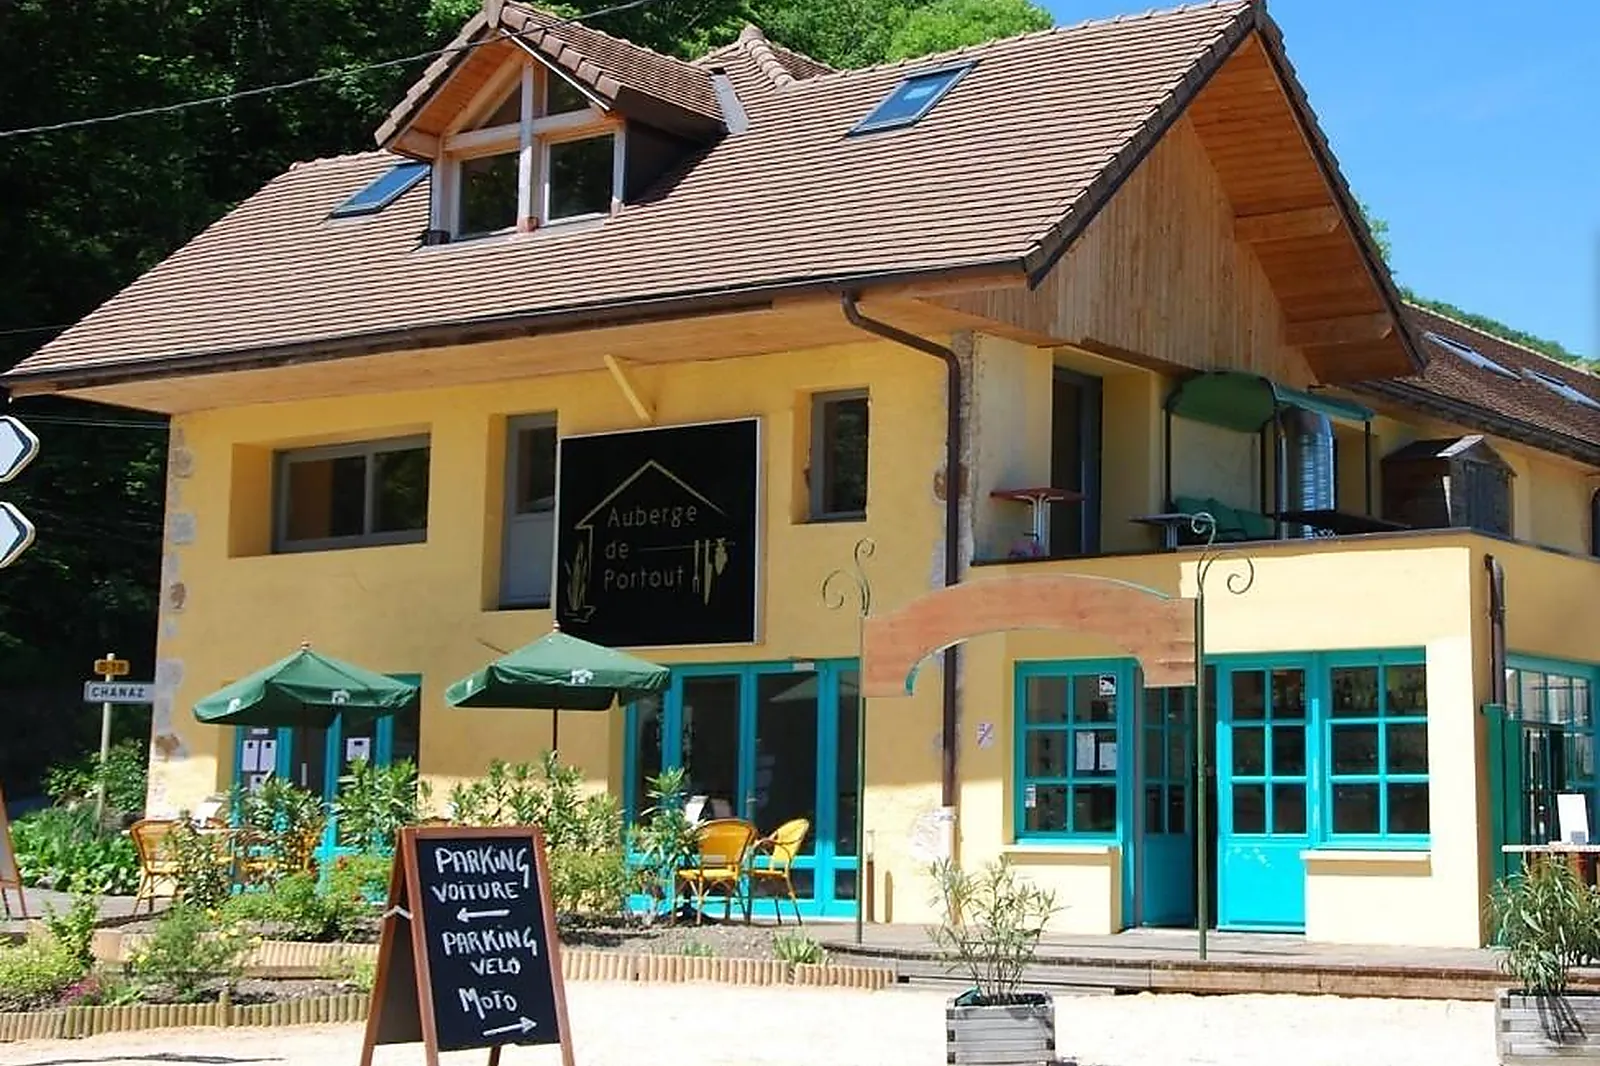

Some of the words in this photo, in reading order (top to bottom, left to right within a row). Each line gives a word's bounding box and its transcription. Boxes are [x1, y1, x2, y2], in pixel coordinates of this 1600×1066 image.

[607, 505, 697, 528] Auberge
[605, 540, 629, 559] de
[604, 565, 684, 592] Portout
[91, 686, 145, 698] CHANAZ
